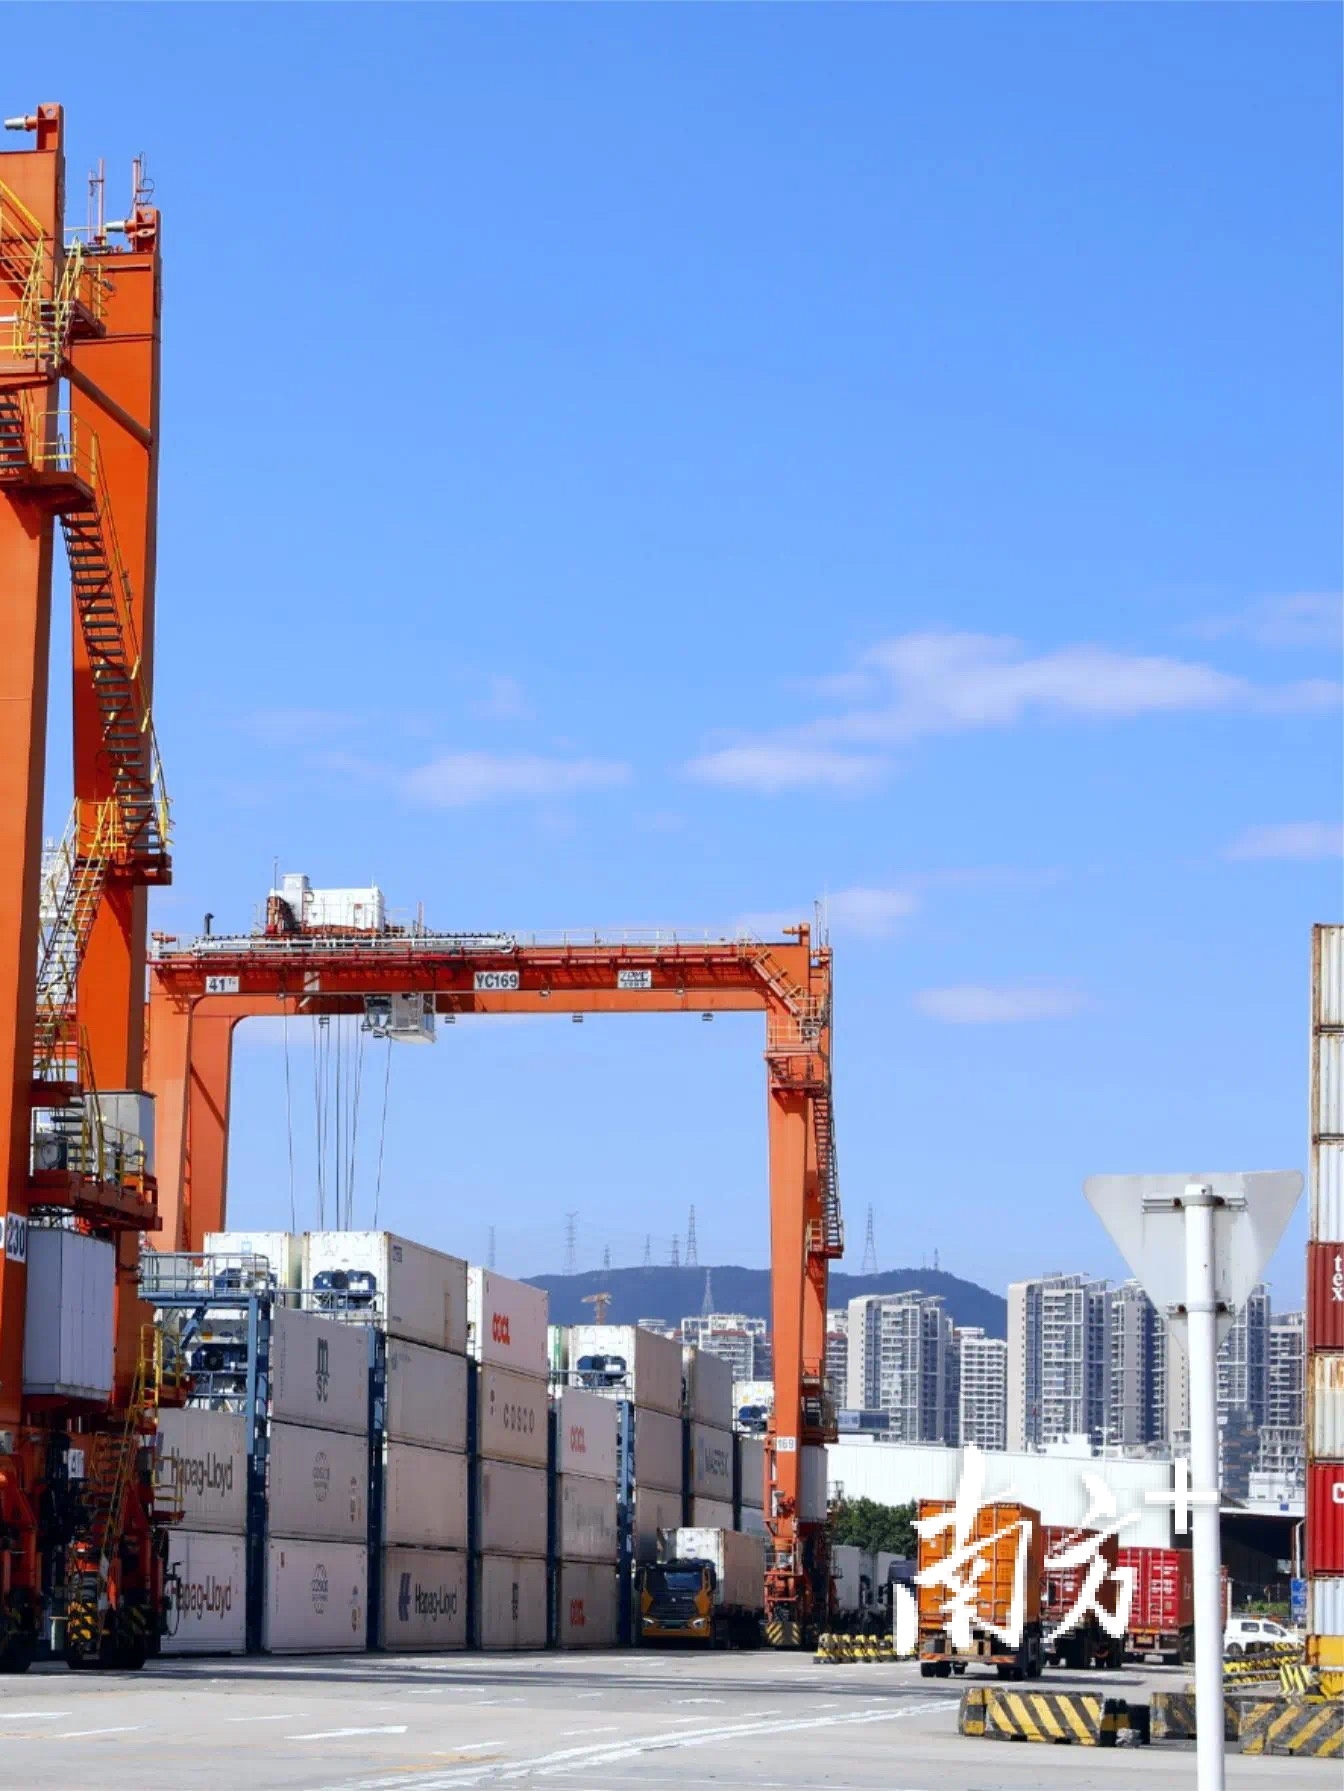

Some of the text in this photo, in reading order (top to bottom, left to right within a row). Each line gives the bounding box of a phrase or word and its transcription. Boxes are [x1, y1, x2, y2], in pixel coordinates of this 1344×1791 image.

[475, 974, 518, 989] YC169
[7, 1219, 25, 1255] 230
[1331, 1255, 1344, 1301] tex
[503, 1403, 535, 1435] COSCO
[778, 1438, 794, 1450] 169
